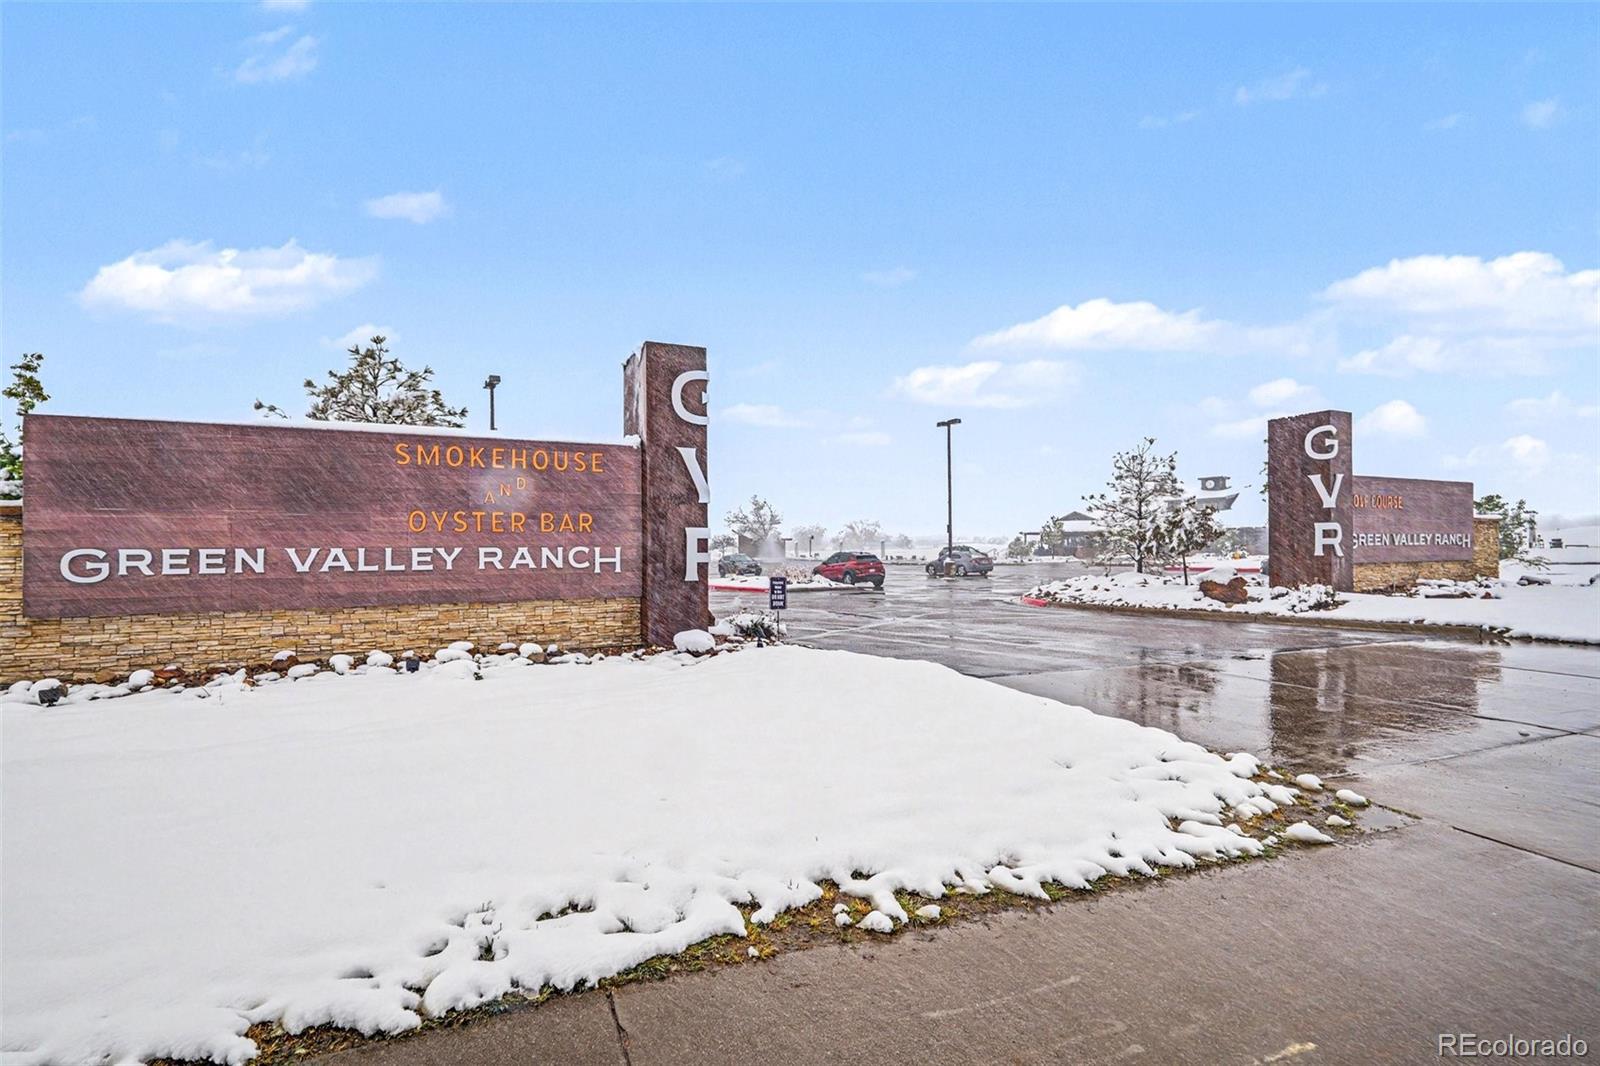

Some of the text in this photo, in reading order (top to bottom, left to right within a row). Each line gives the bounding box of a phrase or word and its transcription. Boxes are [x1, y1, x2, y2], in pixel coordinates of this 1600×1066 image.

[395, 443, 604, 473] SMOKEHOUSE
[483, 477, 527, 504] AND
[1304, 425, 1344, 556] GVR
[408, 510, 593, 533] OYSTER BAR
[1393, 533, 1432, 545] VALLEY
[1434, 533, 1471, 548] RANCH
[60, 546, 622, 584] GREEN VALLEY RANCH
